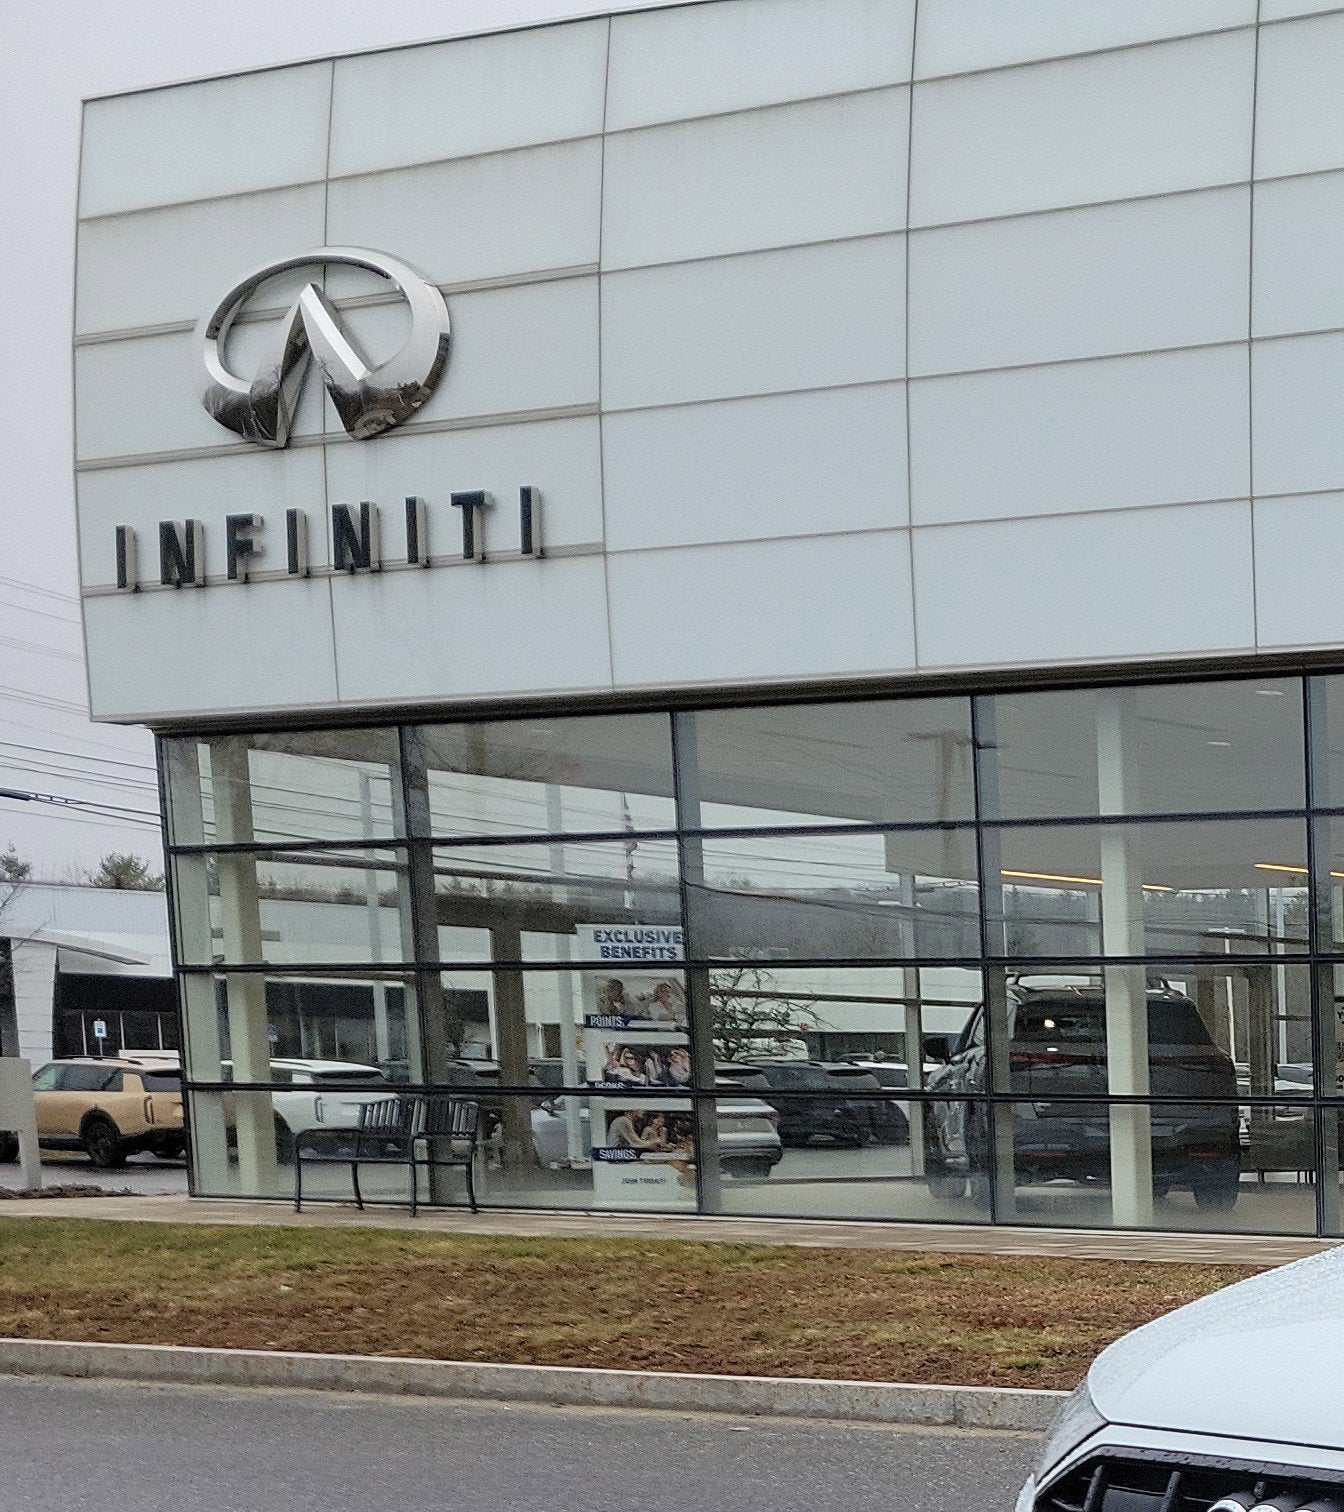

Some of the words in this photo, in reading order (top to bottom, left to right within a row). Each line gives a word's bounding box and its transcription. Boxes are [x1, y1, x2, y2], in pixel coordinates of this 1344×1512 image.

[115, 485, 545, 591] INFINITI
[592, 929, 683, 944] EXCLUSIVE
[600, 945, 677, 959] BENEFITS
